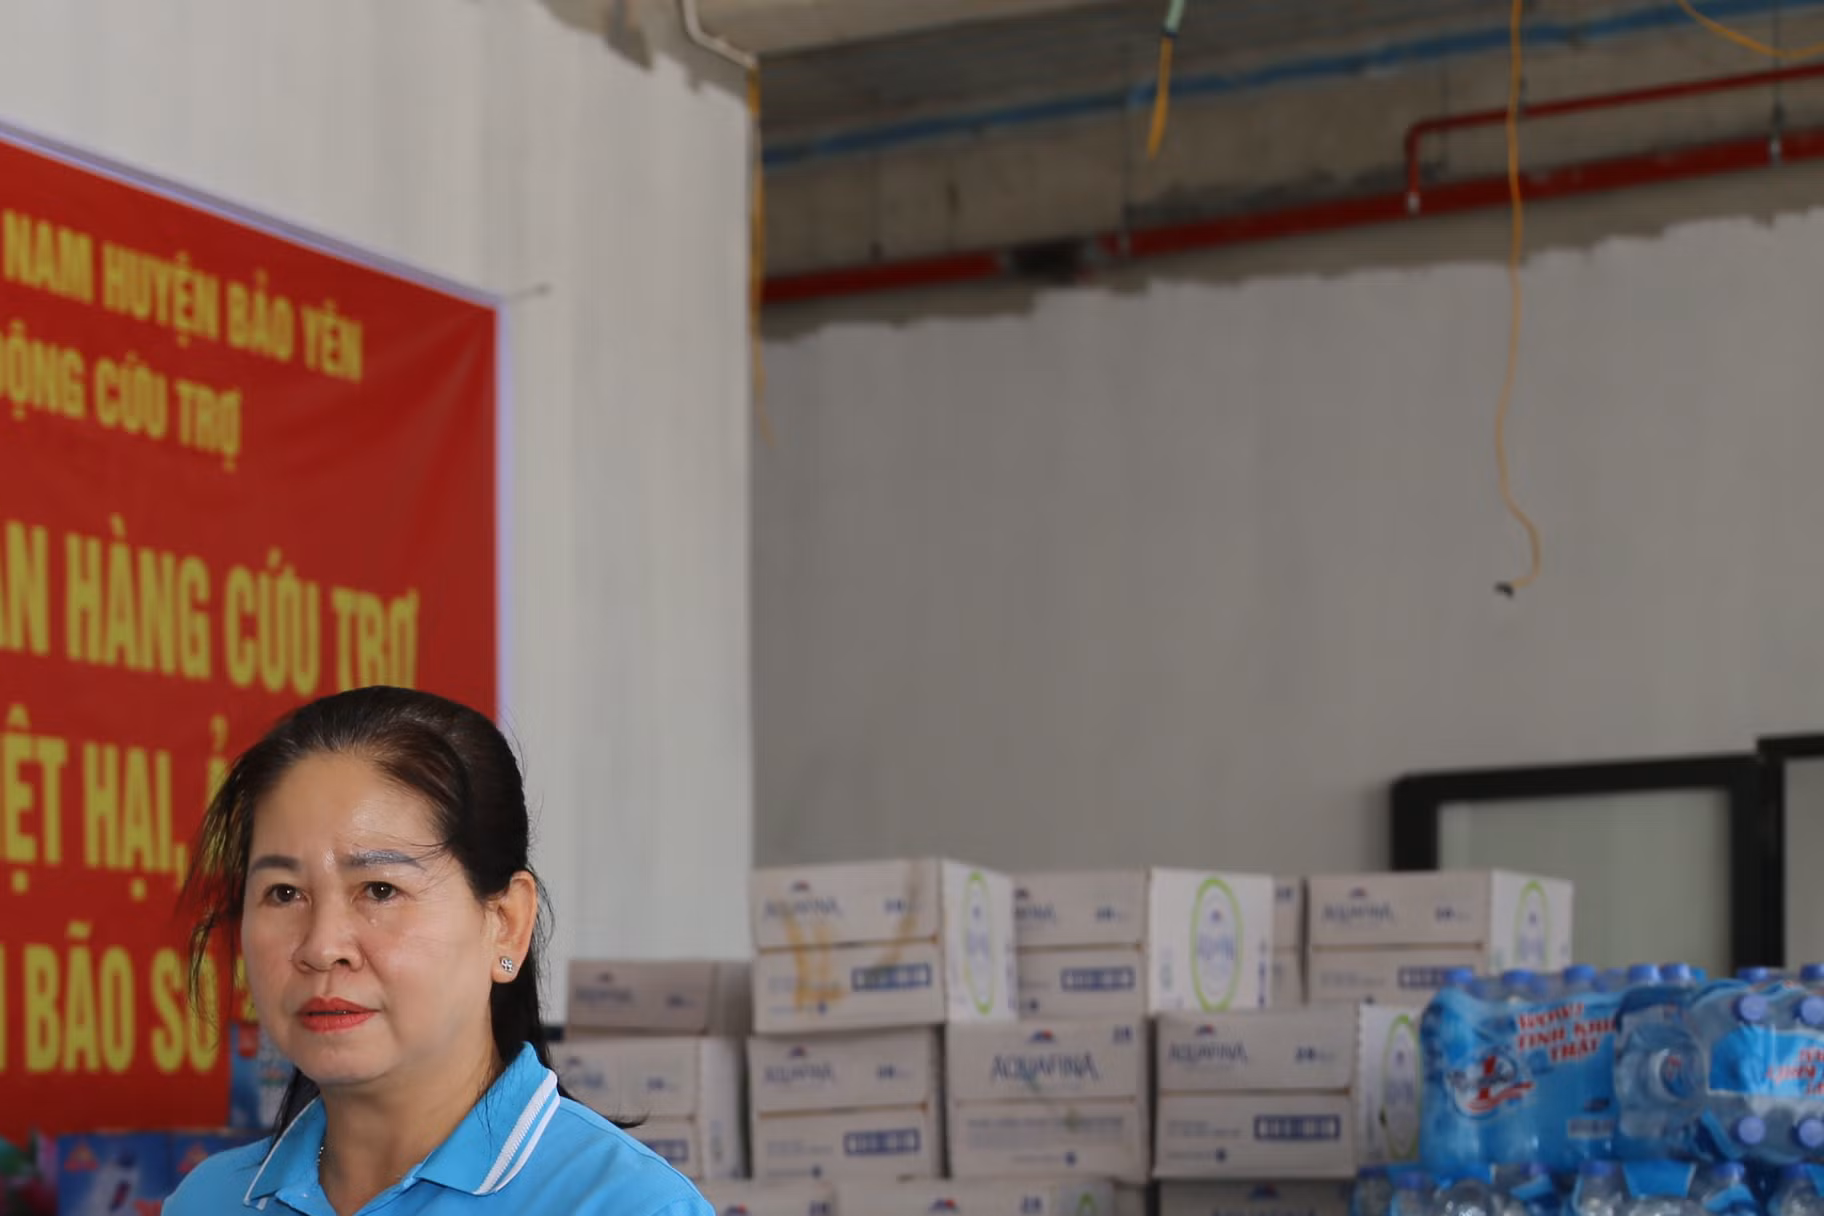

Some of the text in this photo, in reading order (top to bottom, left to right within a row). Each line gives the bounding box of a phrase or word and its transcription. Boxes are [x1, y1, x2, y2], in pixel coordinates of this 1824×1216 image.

[2, 209, 94, 304] NAM
[102, 251, 219, 347] HUYỆN
[227, 269, 294, 362] BẢO
[301, 299, 363, 384] YÊN
[95, 350, 168, 439] CỨU
[176, 378, 242, 472] TRỢ
[65, 512, 212, 680] HÀNG
[224, 548, 320, 696] CỨU
[84, 742, 188, 901] HẠI,
[23, 920, 136, 1074] BÃO
[991, 1053, 1102, 1082] AQUAFINA
